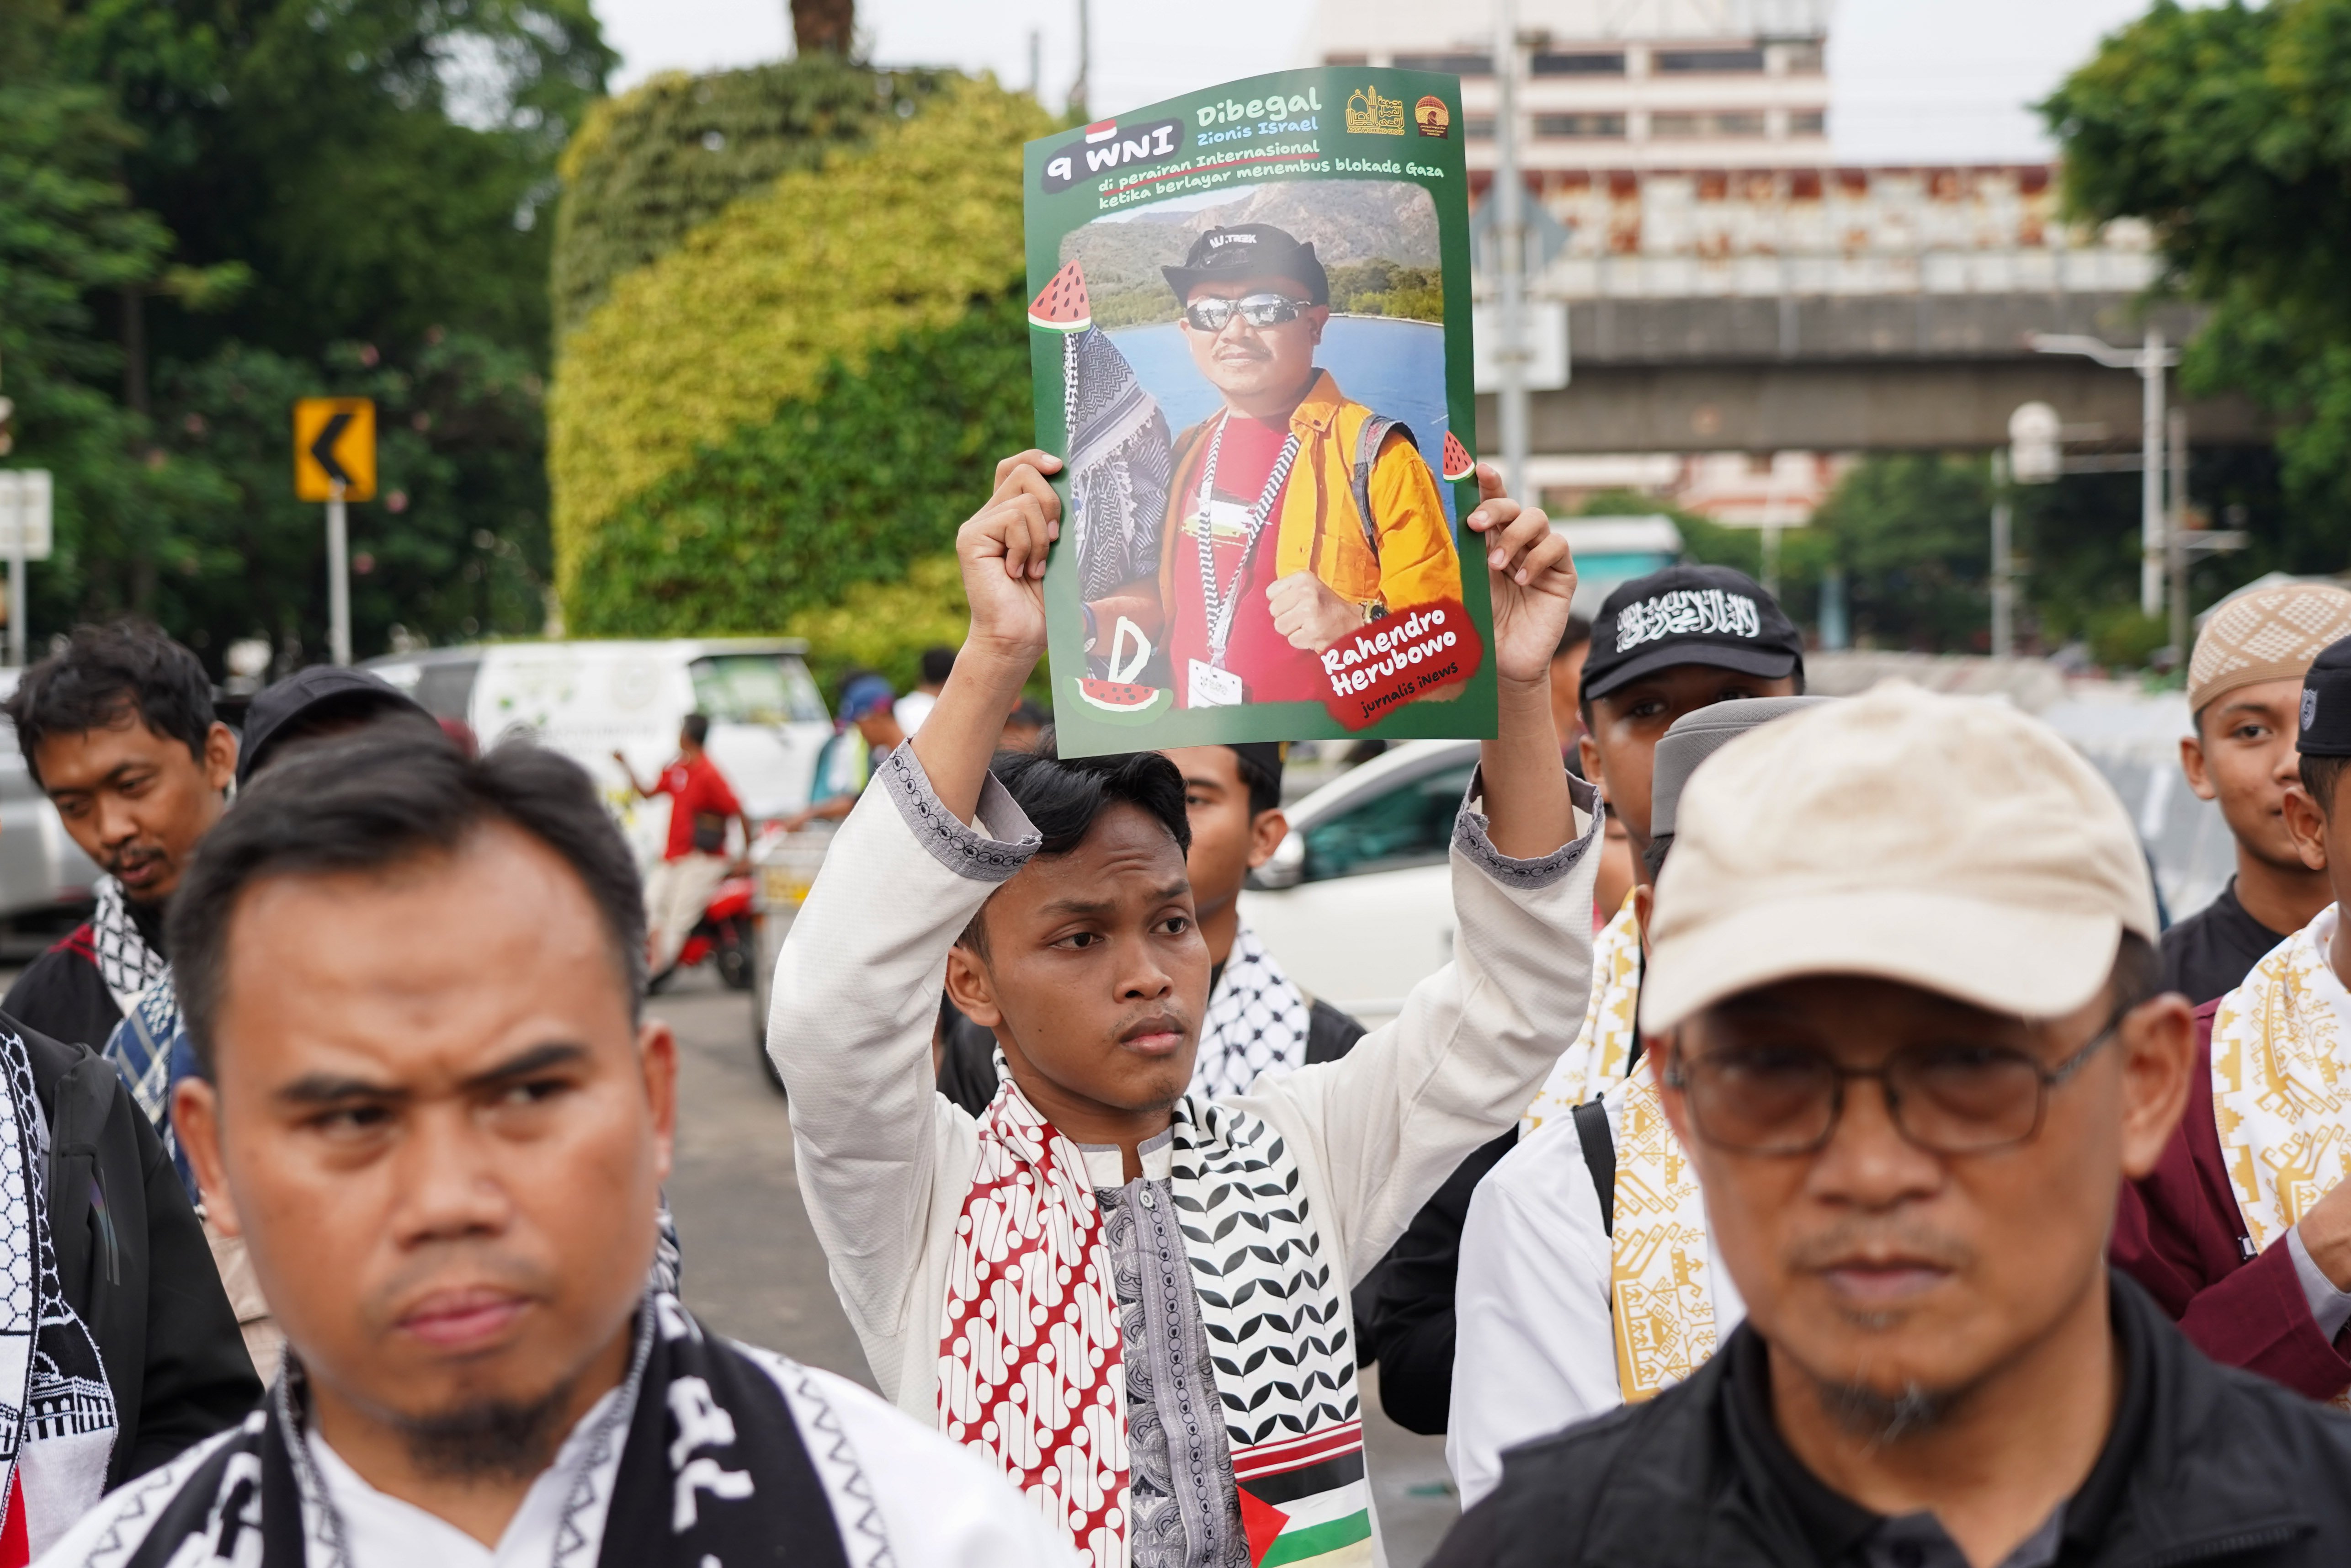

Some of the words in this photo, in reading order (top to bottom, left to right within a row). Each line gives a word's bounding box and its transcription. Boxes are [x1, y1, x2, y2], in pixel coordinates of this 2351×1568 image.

[1197, 87, 1322, 127] Dibegal
[1197, 126, 1252, 146] Zionis
[1257, 116, 1319, 135] Israel
[1086, 125, 1174, 172] WNI
[1098, 178, 1113, 192] di
[1119, 161, 1191, 191] perairan
[1196, 139, 1320, 168] Internasional
[1099, 189, 1151, 209] ketika
[1156, 171, 1231, 194] berlayar
[1236, 159, 1330, 178] menembus
[1335, 158, 1401, 174] blokade
[1405, 162, 1444, 178] Gaza
[1320, 609, 1445, 675] Rahendro
[1330, 631, 1457, 697] Herubowo
[1361, 681, 1415, 719] jurnalis
[1417, 662, 1458, 688] iNews
